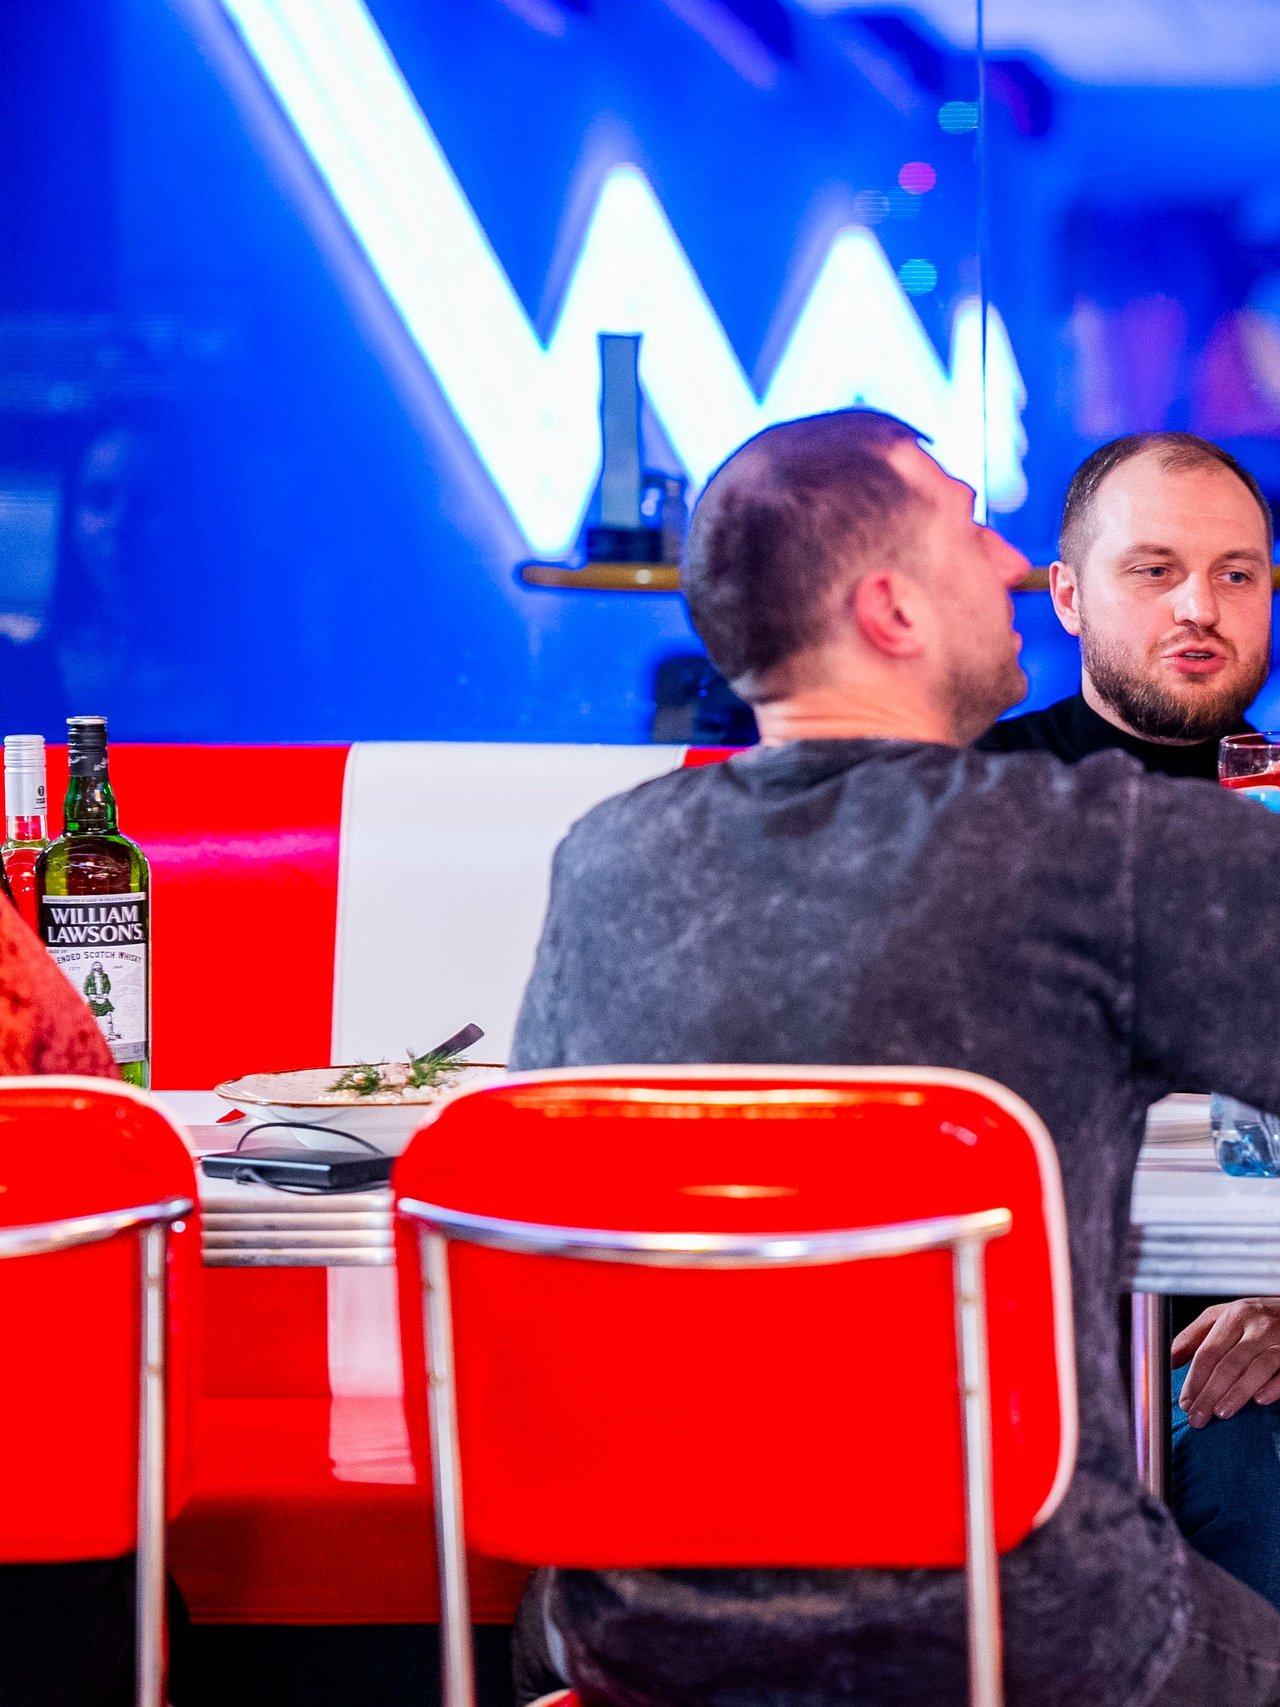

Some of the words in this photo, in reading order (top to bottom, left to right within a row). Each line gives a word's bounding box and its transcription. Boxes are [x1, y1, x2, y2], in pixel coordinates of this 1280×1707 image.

[50, 905, 139, 925] WILLIAM
[47, 924, 144, 943] LAWSON'S
[54, 953, 81, 965] LENDED
[84, 951, 115, 959] SCOTCH
[118, 951, 142, 963] WHISKY
